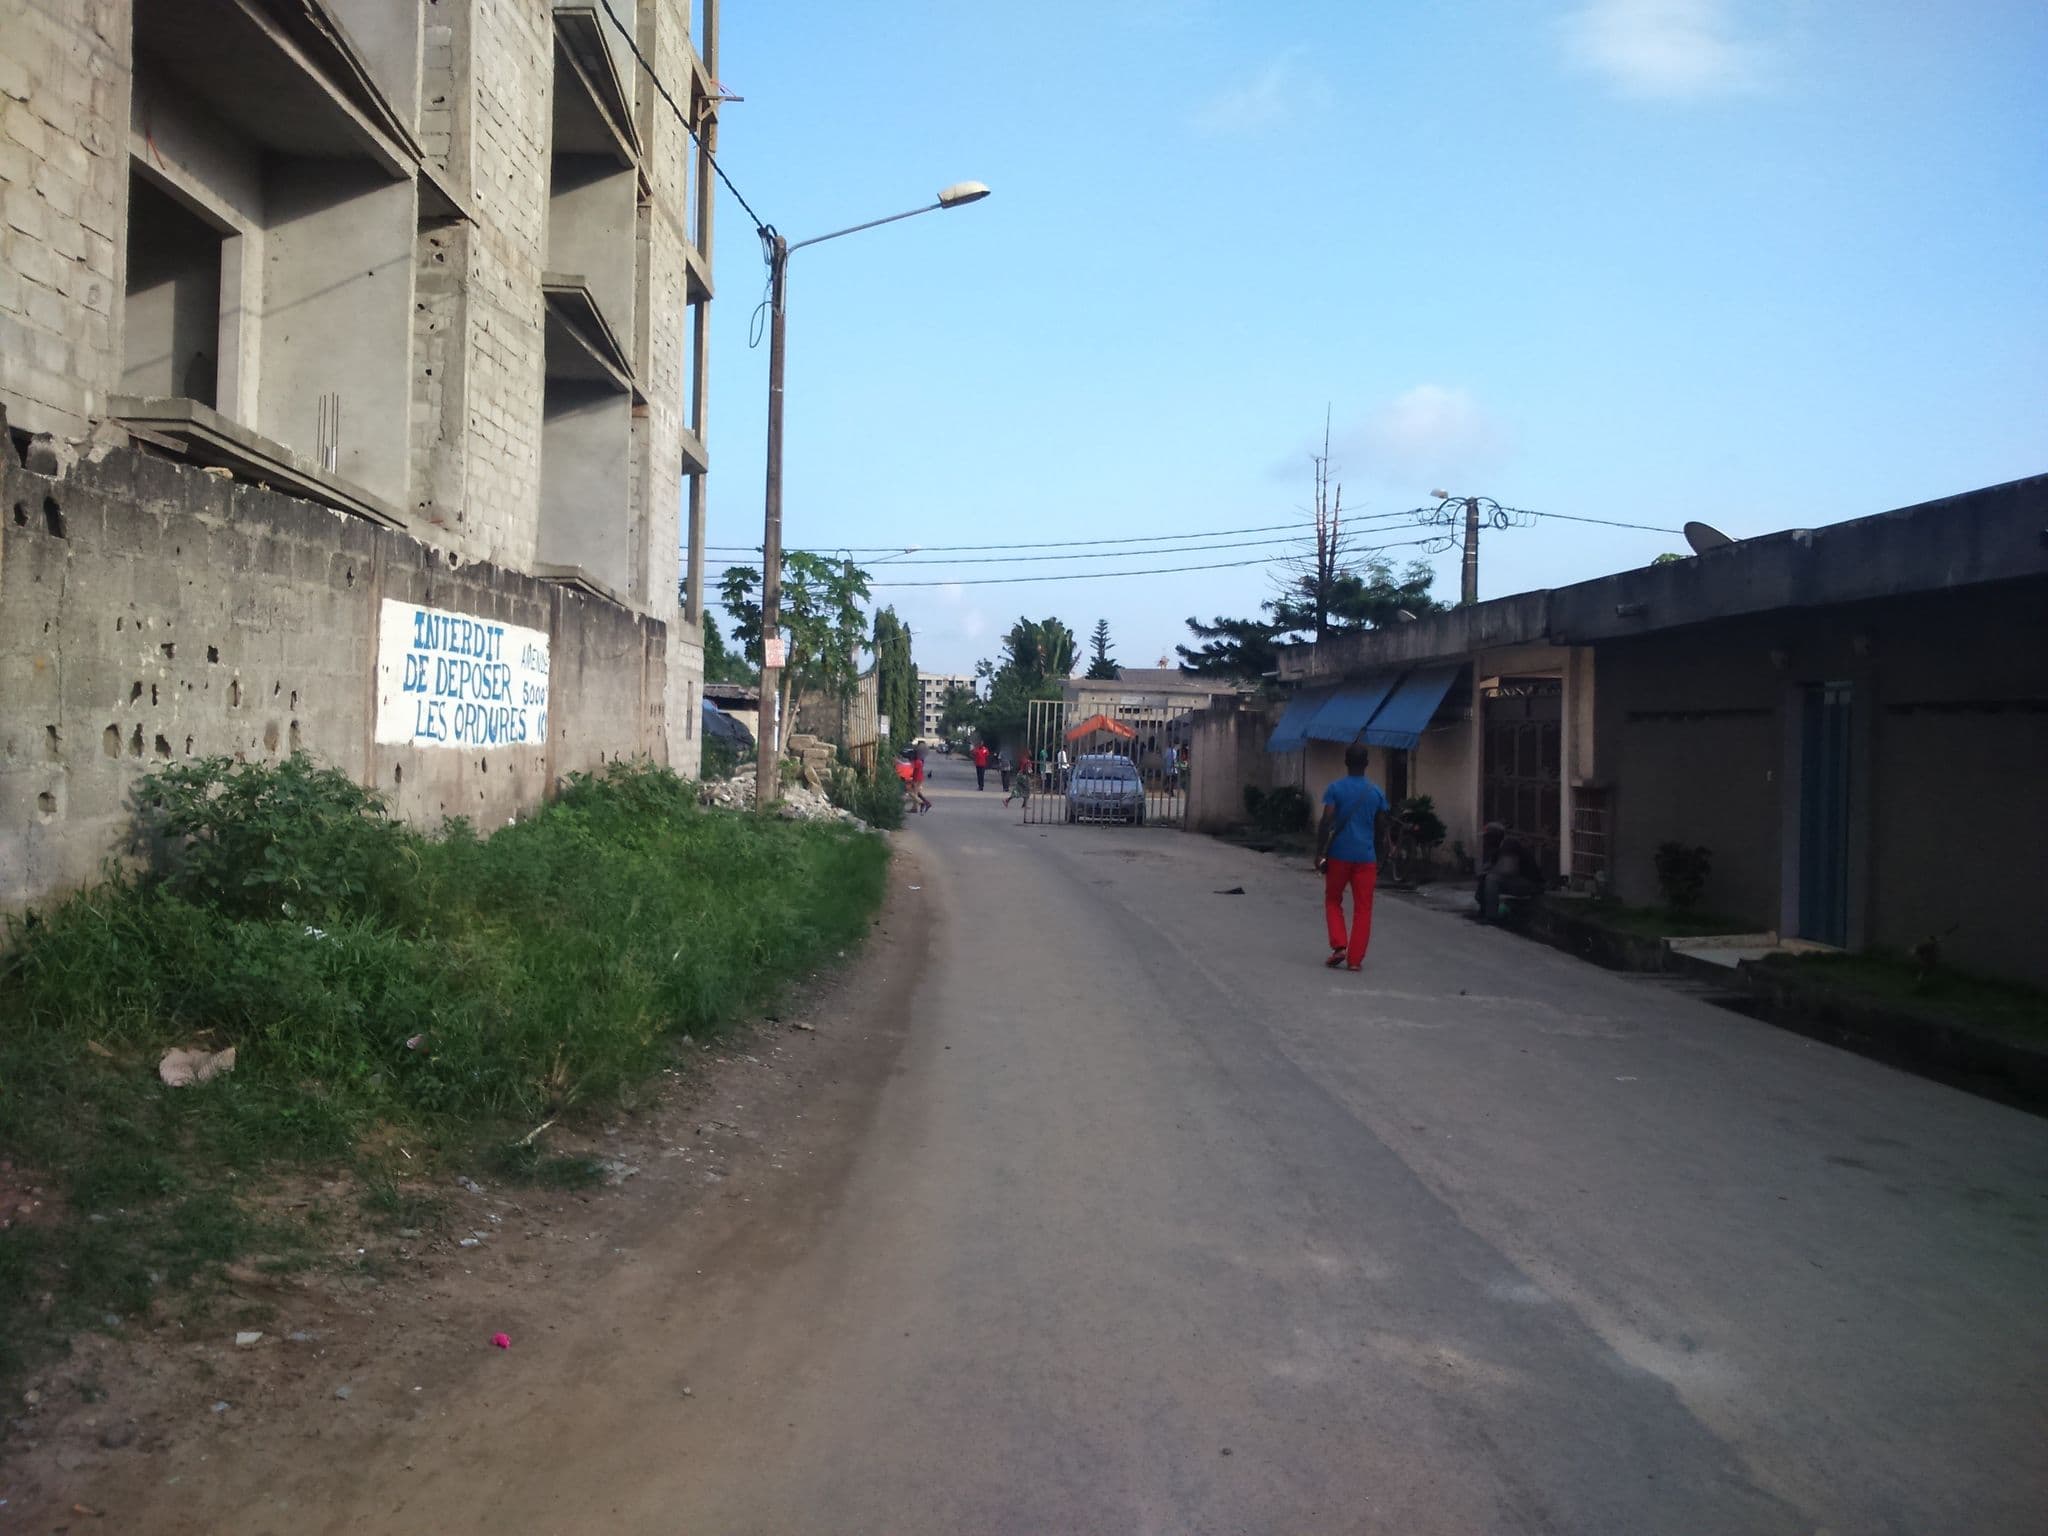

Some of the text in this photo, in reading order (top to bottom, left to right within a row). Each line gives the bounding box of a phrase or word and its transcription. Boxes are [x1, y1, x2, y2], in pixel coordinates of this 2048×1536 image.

[413, 611, 504, 662] INTERDIT
[403, 653, 513, 704] DE DEPOSER
[415, 700, 447, 742] LES
[454, 703, 527, 745] ORDURES
